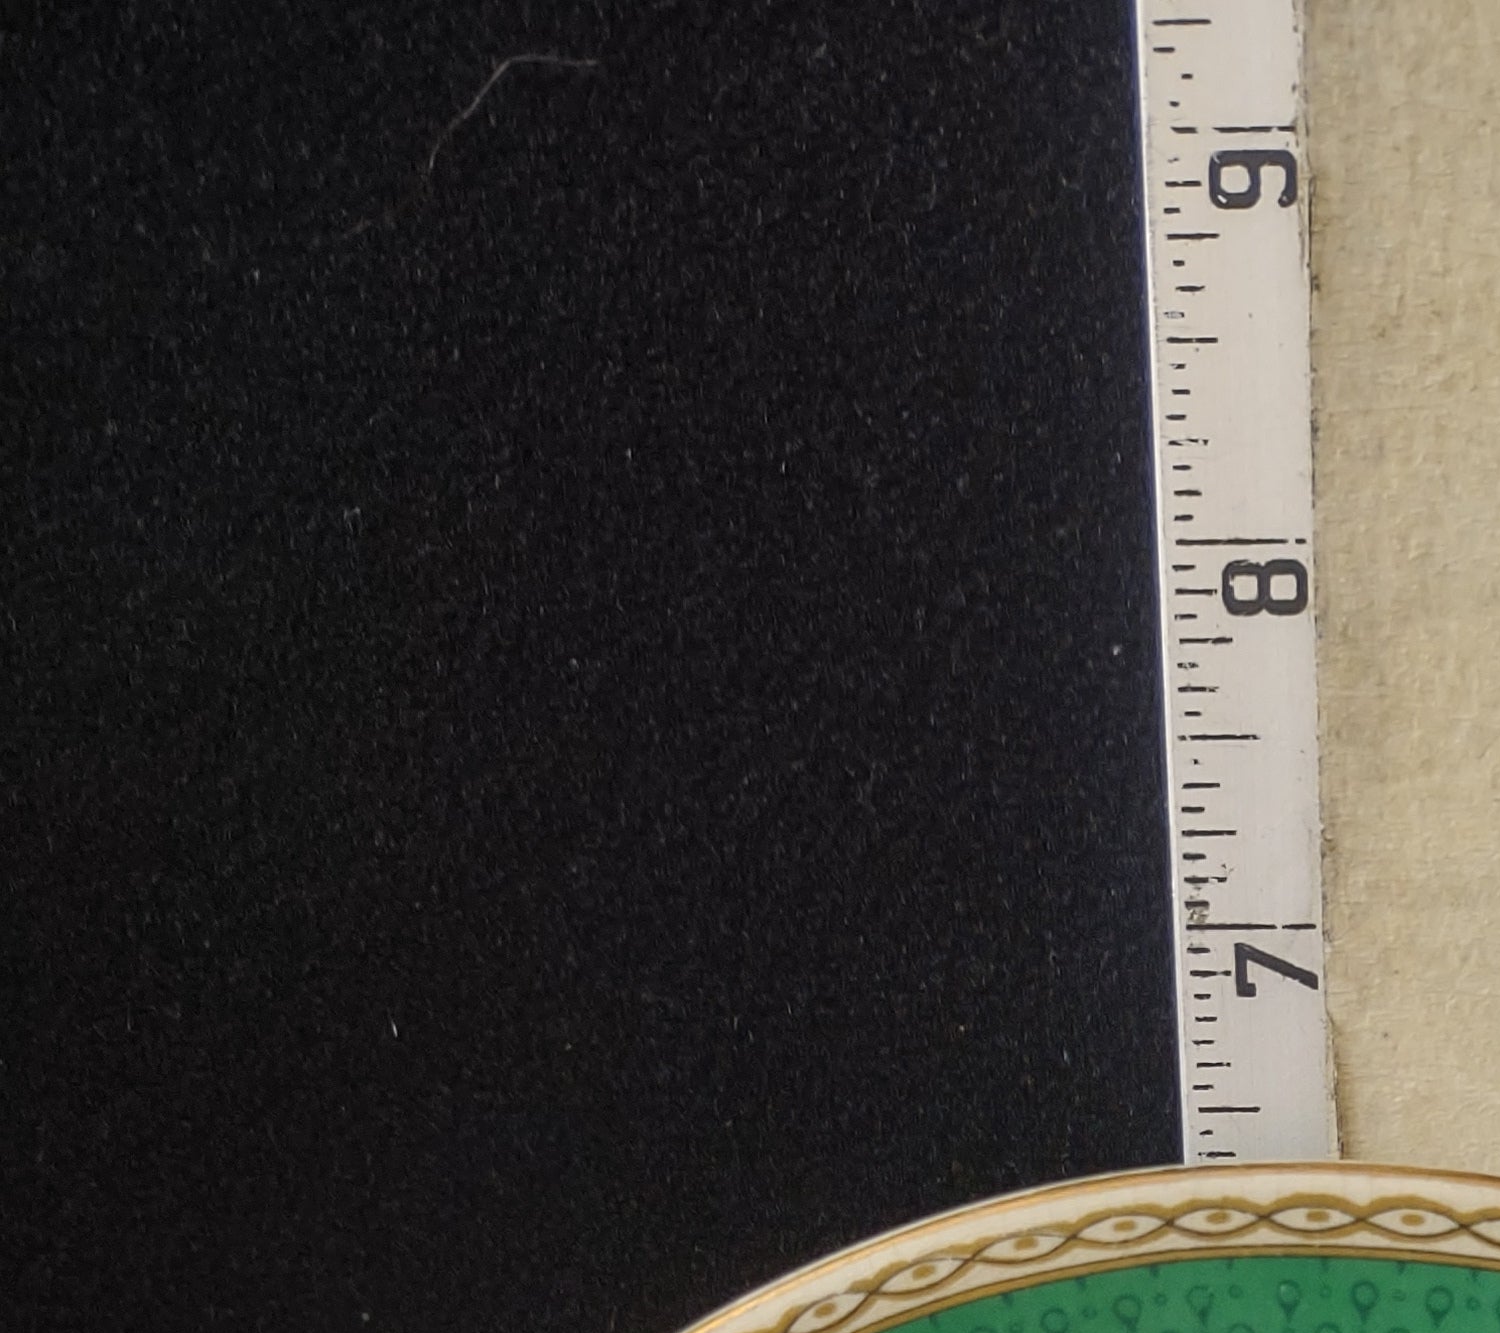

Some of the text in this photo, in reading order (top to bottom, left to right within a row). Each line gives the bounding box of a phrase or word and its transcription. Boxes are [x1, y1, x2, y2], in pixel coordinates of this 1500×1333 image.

[1208, 149, 1298, 209] 9
[1221, 558, 1308, 616] 8
[1234, 942, 1318, 998] 7
